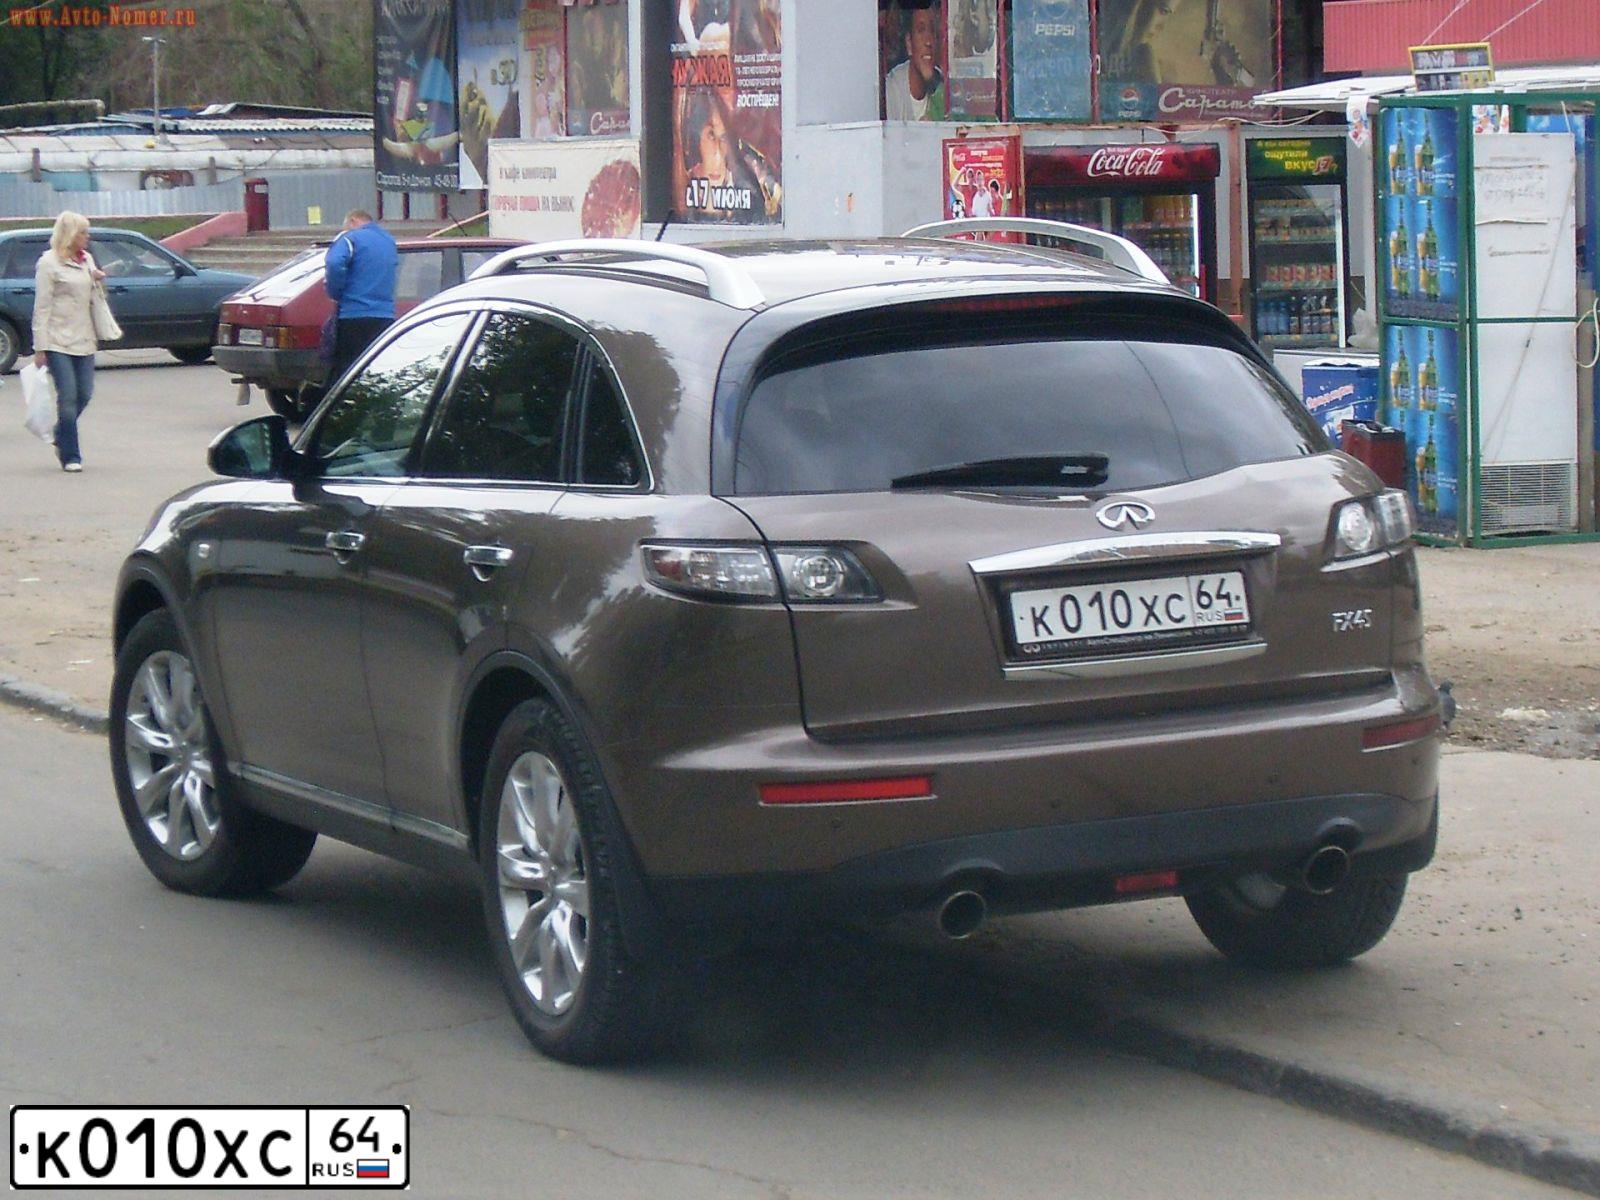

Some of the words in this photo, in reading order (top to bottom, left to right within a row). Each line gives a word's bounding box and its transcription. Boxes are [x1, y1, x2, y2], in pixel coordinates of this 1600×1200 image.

[1035, 23, 1075, 36] PEPSI
[1087, 147, 1166, 178] Coca-Cola
[691, 178, 709, 208] 17
[1196, 578, 1232, 609] 64
[1197, 611, 1222, 624] RUS
[1332, 609, 1373, 632] FX45
